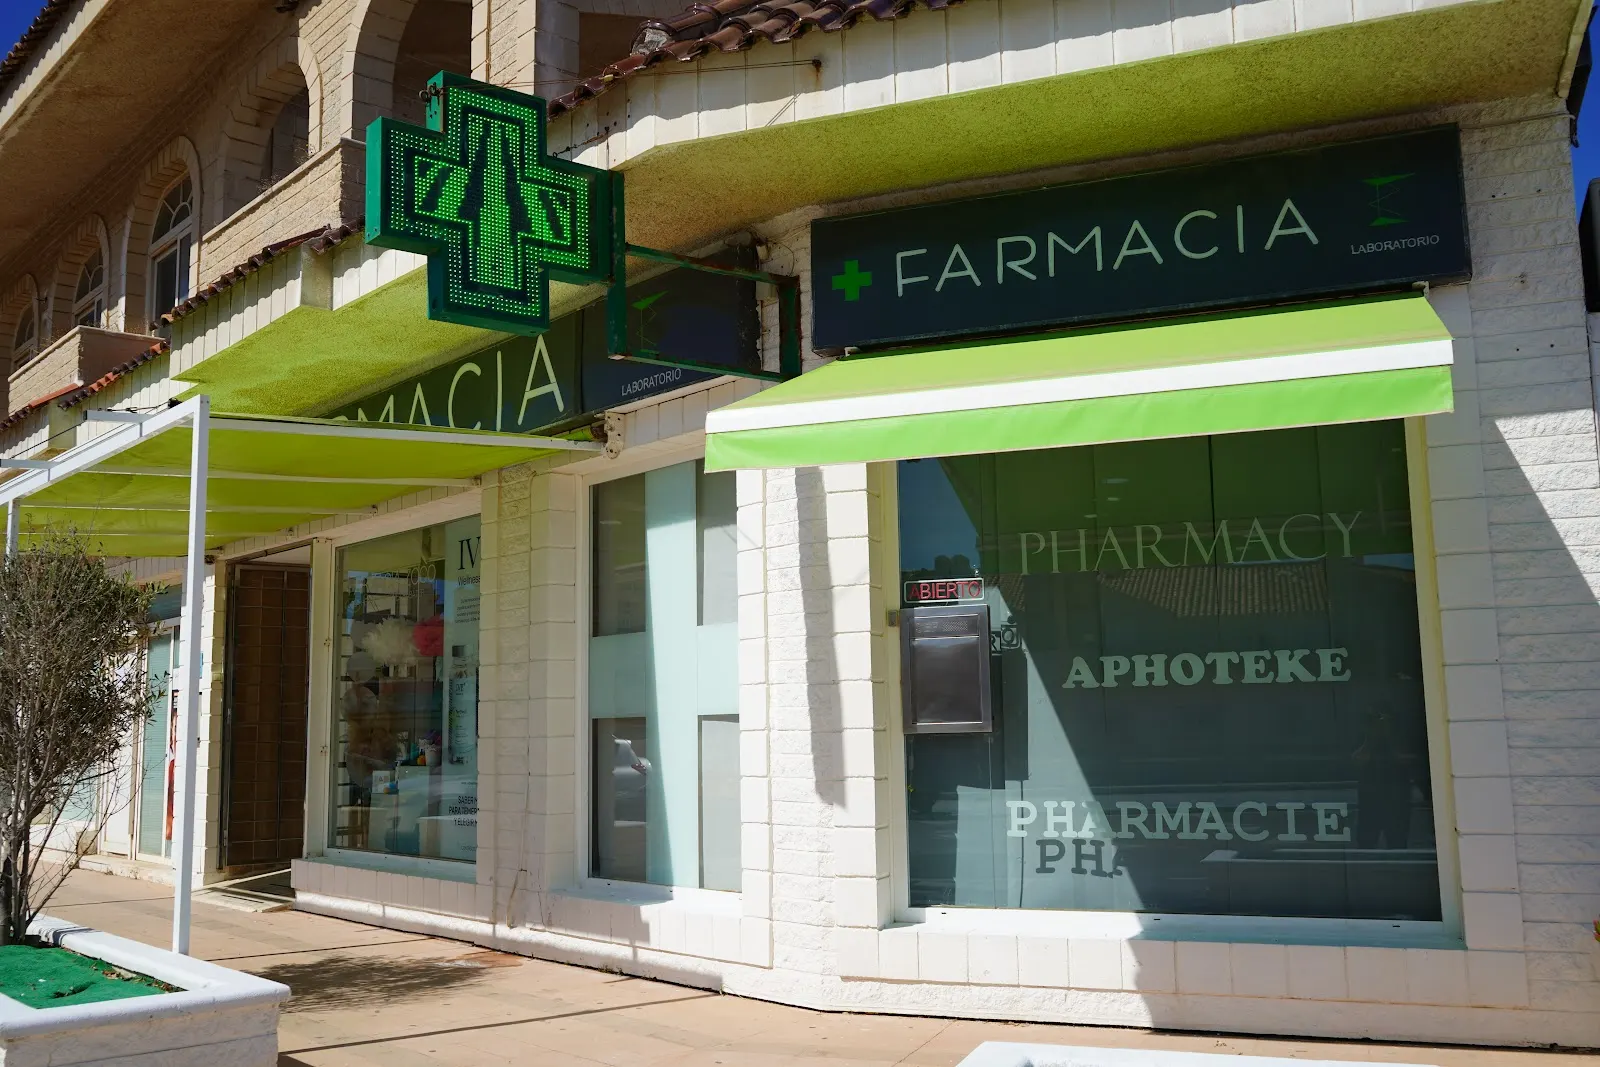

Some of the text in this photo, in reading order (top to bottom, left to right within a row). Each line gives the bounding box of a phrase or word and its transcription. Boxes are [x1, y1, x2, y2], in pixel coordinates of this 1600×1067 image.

[896, 198, 1319, 298] FARMACIA
[1351, 234, 1440, 255] LABORATORIO
[621, 368, 682, 396] LABORATORIO
[1018, 510, 1363, 576] PHARMACY
[909, 580, 981, 600] ABIERTO
[1062, 647, 1352, 689] APHOTEKE
[1005, 800, 1351, 842] PHARMACIE
